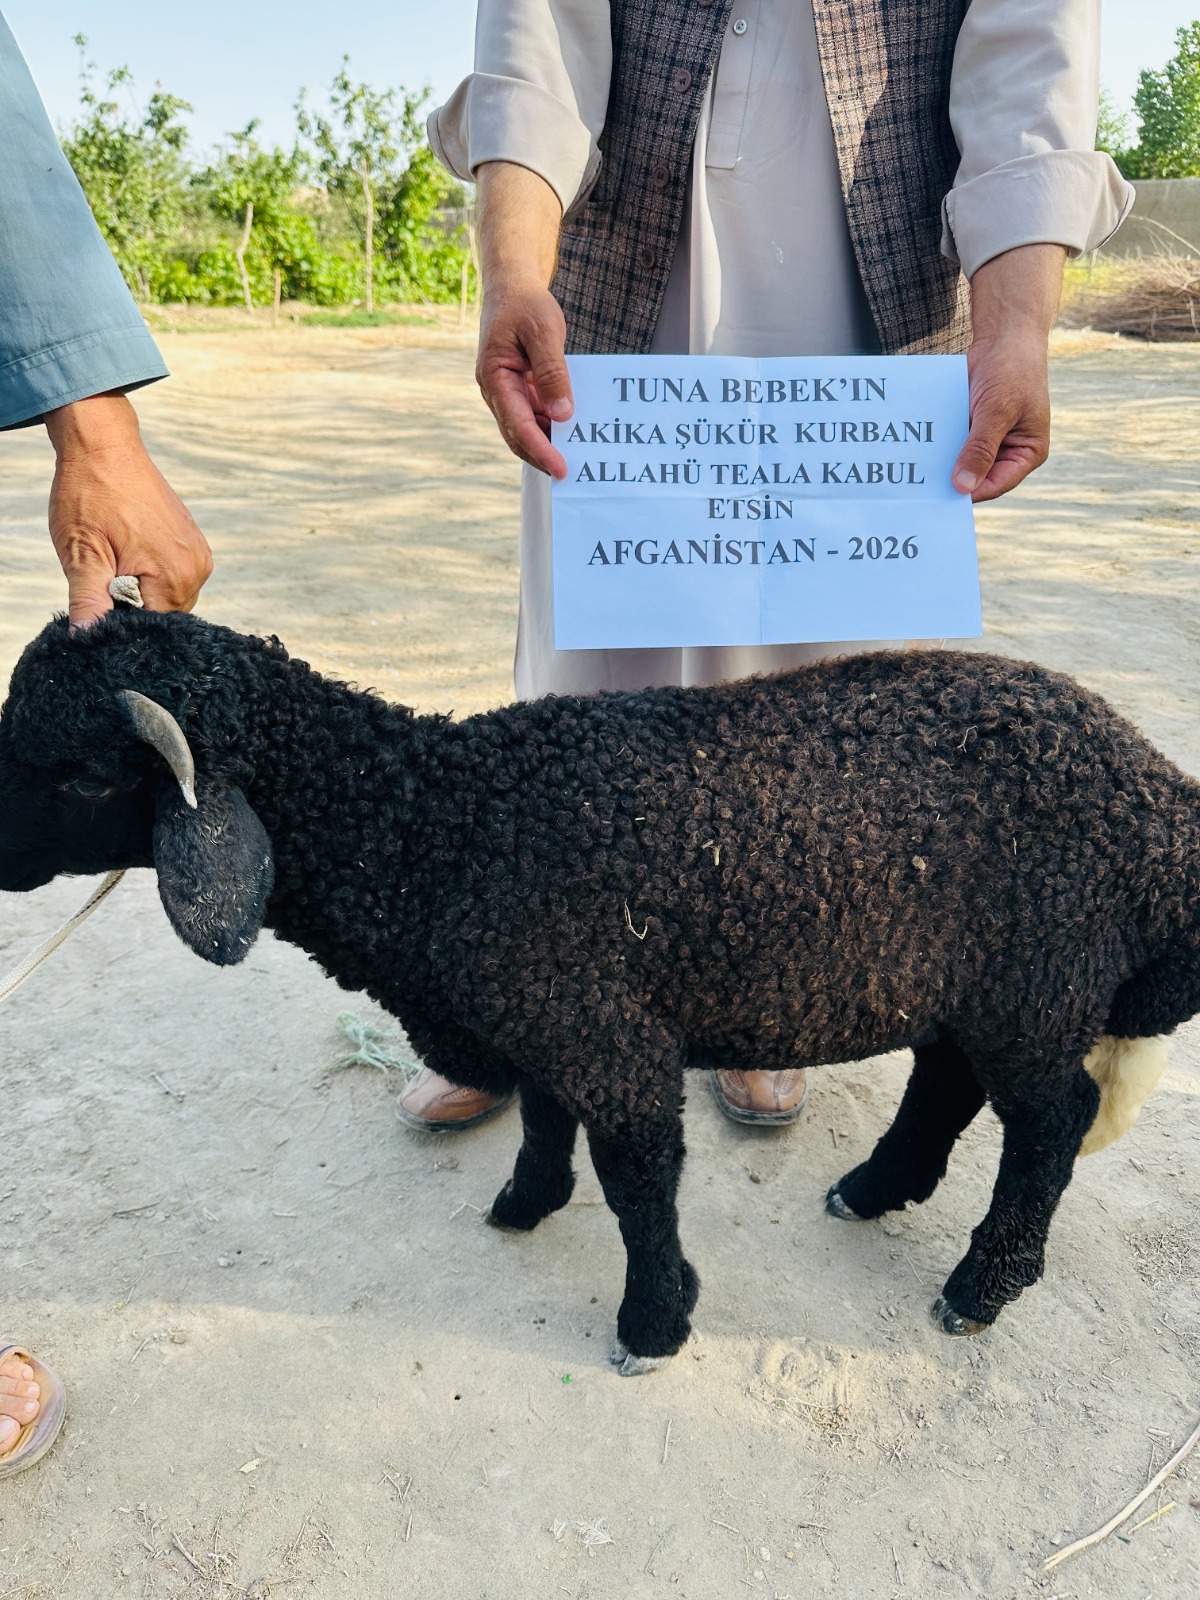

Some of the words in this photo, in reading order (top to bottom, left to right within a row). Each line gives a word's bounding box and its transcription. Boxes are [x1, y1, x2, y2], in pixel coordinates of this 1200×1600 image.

[612, 377, 711, 403] TUNA
[567, 417, 667, 445] AKİKA
[675, 417, 780, 451] ŞÜKÜR
[793, 421, 935, 444] KURBANI
[574, 458, 702, 485] ALLAHÜ
[710, 462, 813, 486] TEALA
[820, 462, 926, 485] KABUL
[706, 494, 793, 521] ETSİN
[586, 533, 817, 566] AFGANİSTAN
[848, 535, 919, 561] 2026
